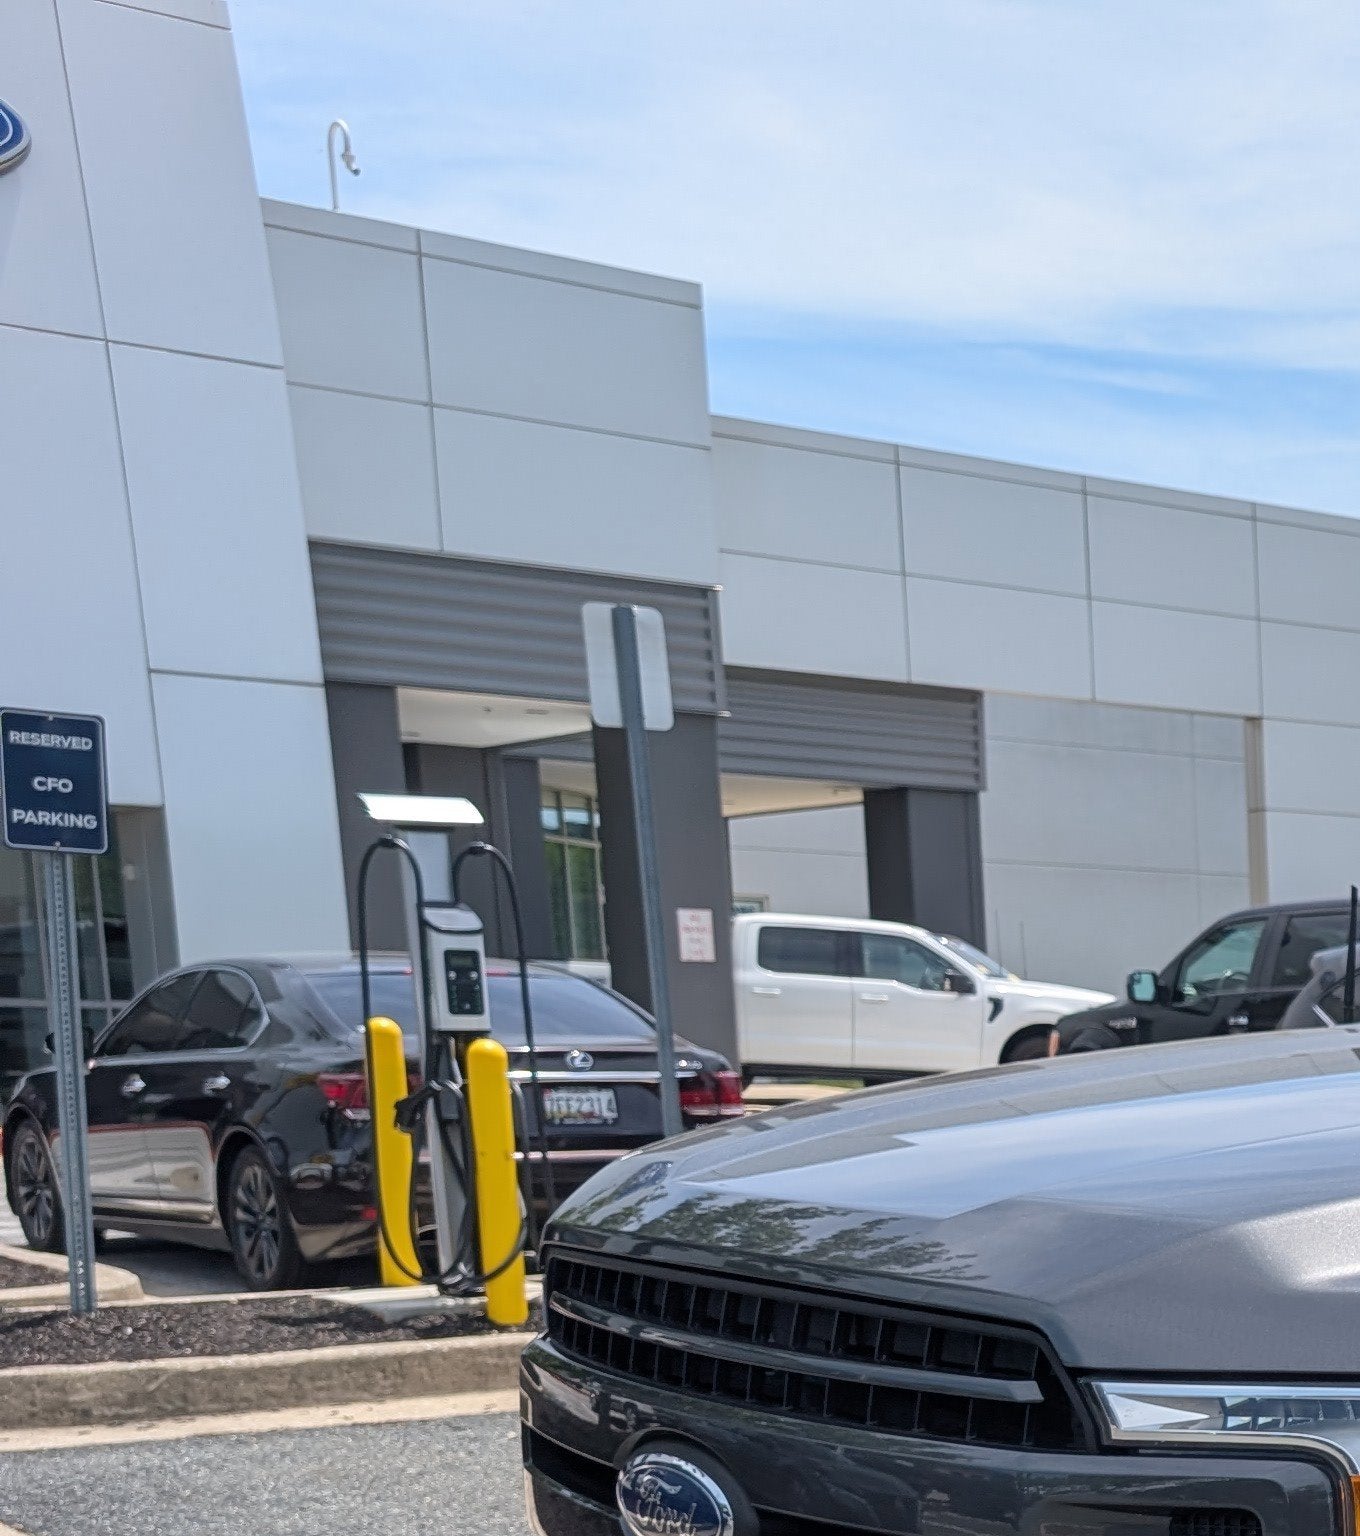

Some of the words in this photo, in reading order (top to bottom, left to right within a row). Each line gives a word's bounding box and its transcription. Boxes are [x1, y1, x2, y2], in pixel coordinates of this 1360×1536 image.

[9, 730, 93, 751] RESERVED
[32, 776, 74, 794] CFO
[12, 808, 98, 830] PARKING
